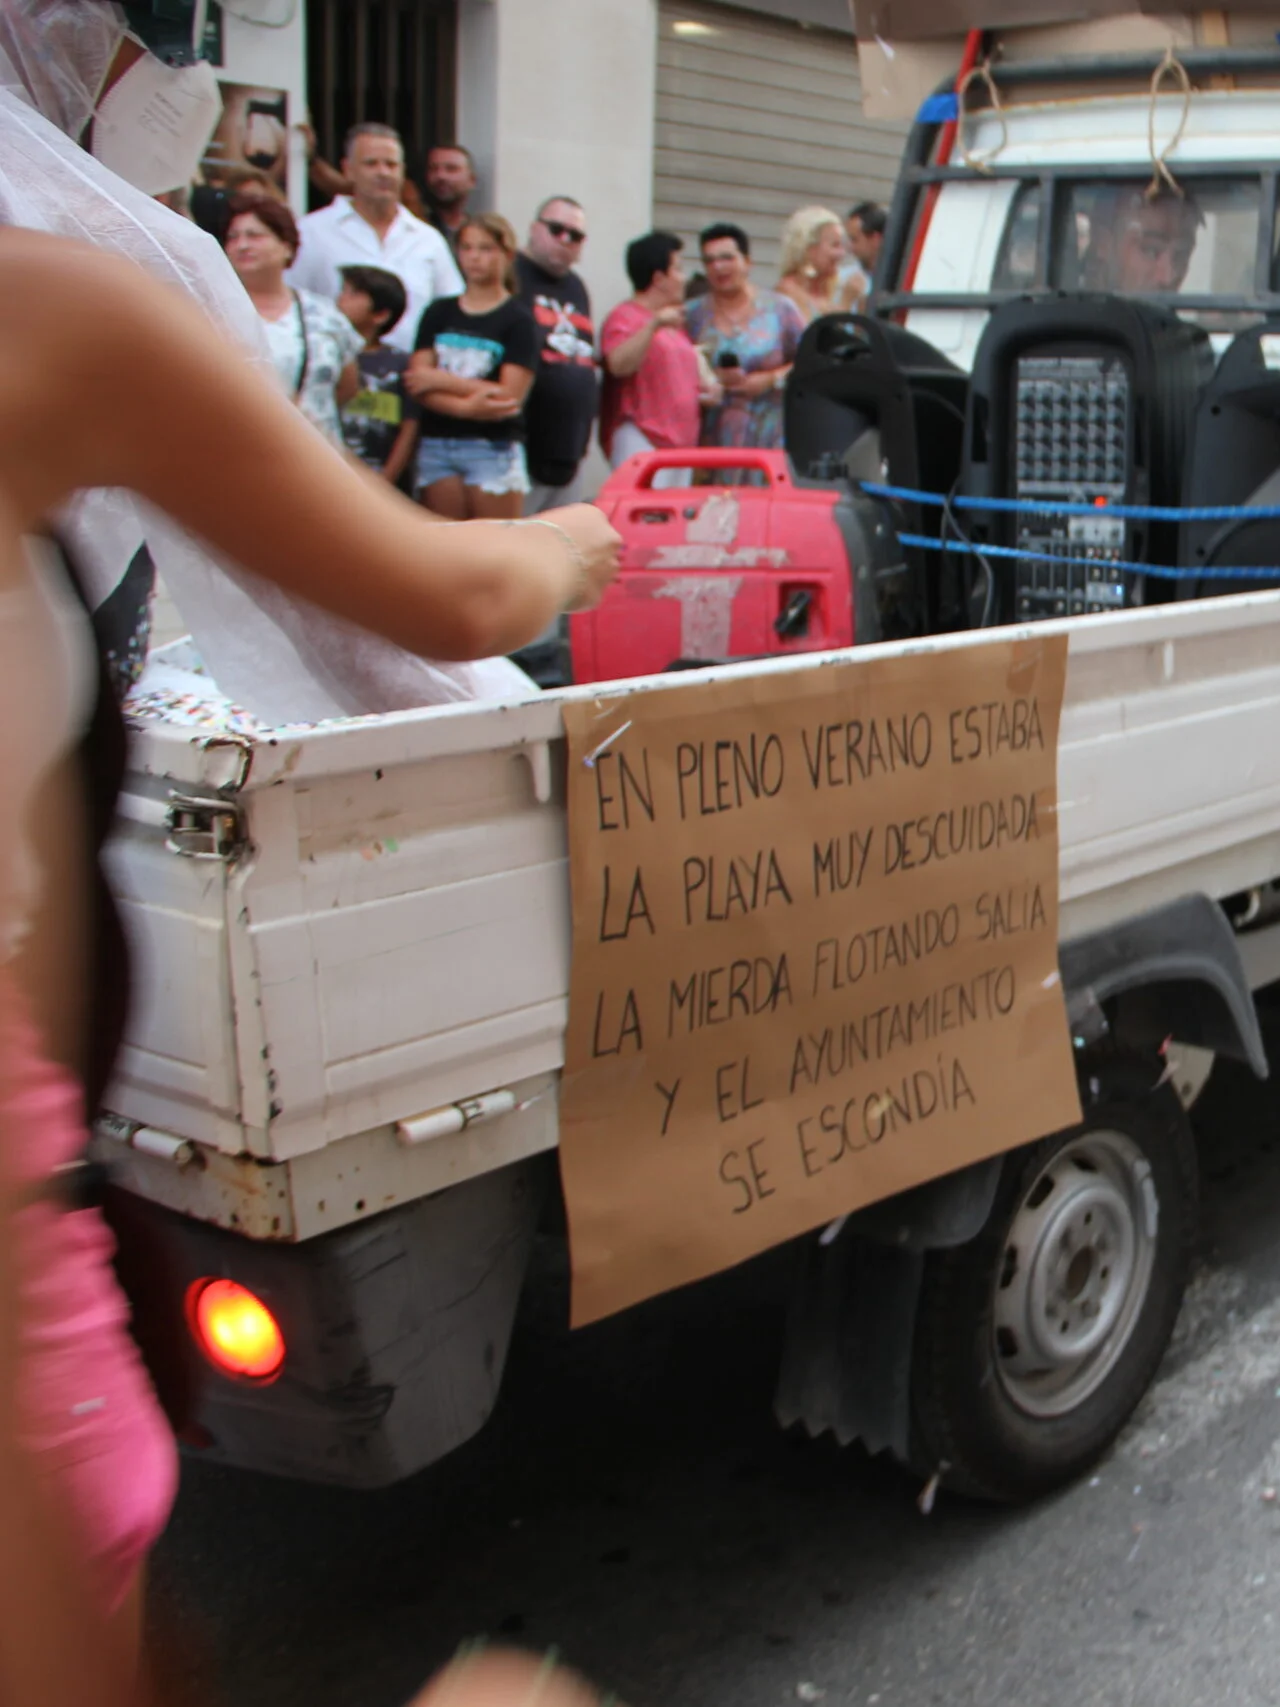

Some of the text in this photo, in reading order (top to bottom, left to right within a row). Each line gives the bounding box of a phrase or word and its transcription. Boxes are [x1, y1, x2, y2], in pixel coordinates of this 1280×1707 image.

[596, 698, 1044, 831] EN PLENO VERANO ESTABA
[600, 793, 1041, 942] LA PLAYA MUY DESCUIDADA
[591, 990, 643, 1060] LA
[666, 954, 794, 1039] MIERDA
[812, 905, 959, 998] FLOTANDO
[656, 966, 1016, 1136] Y EL AYUNTAMIENTO
[718, 1054, 976, 1215] SE ESCONDÍA
